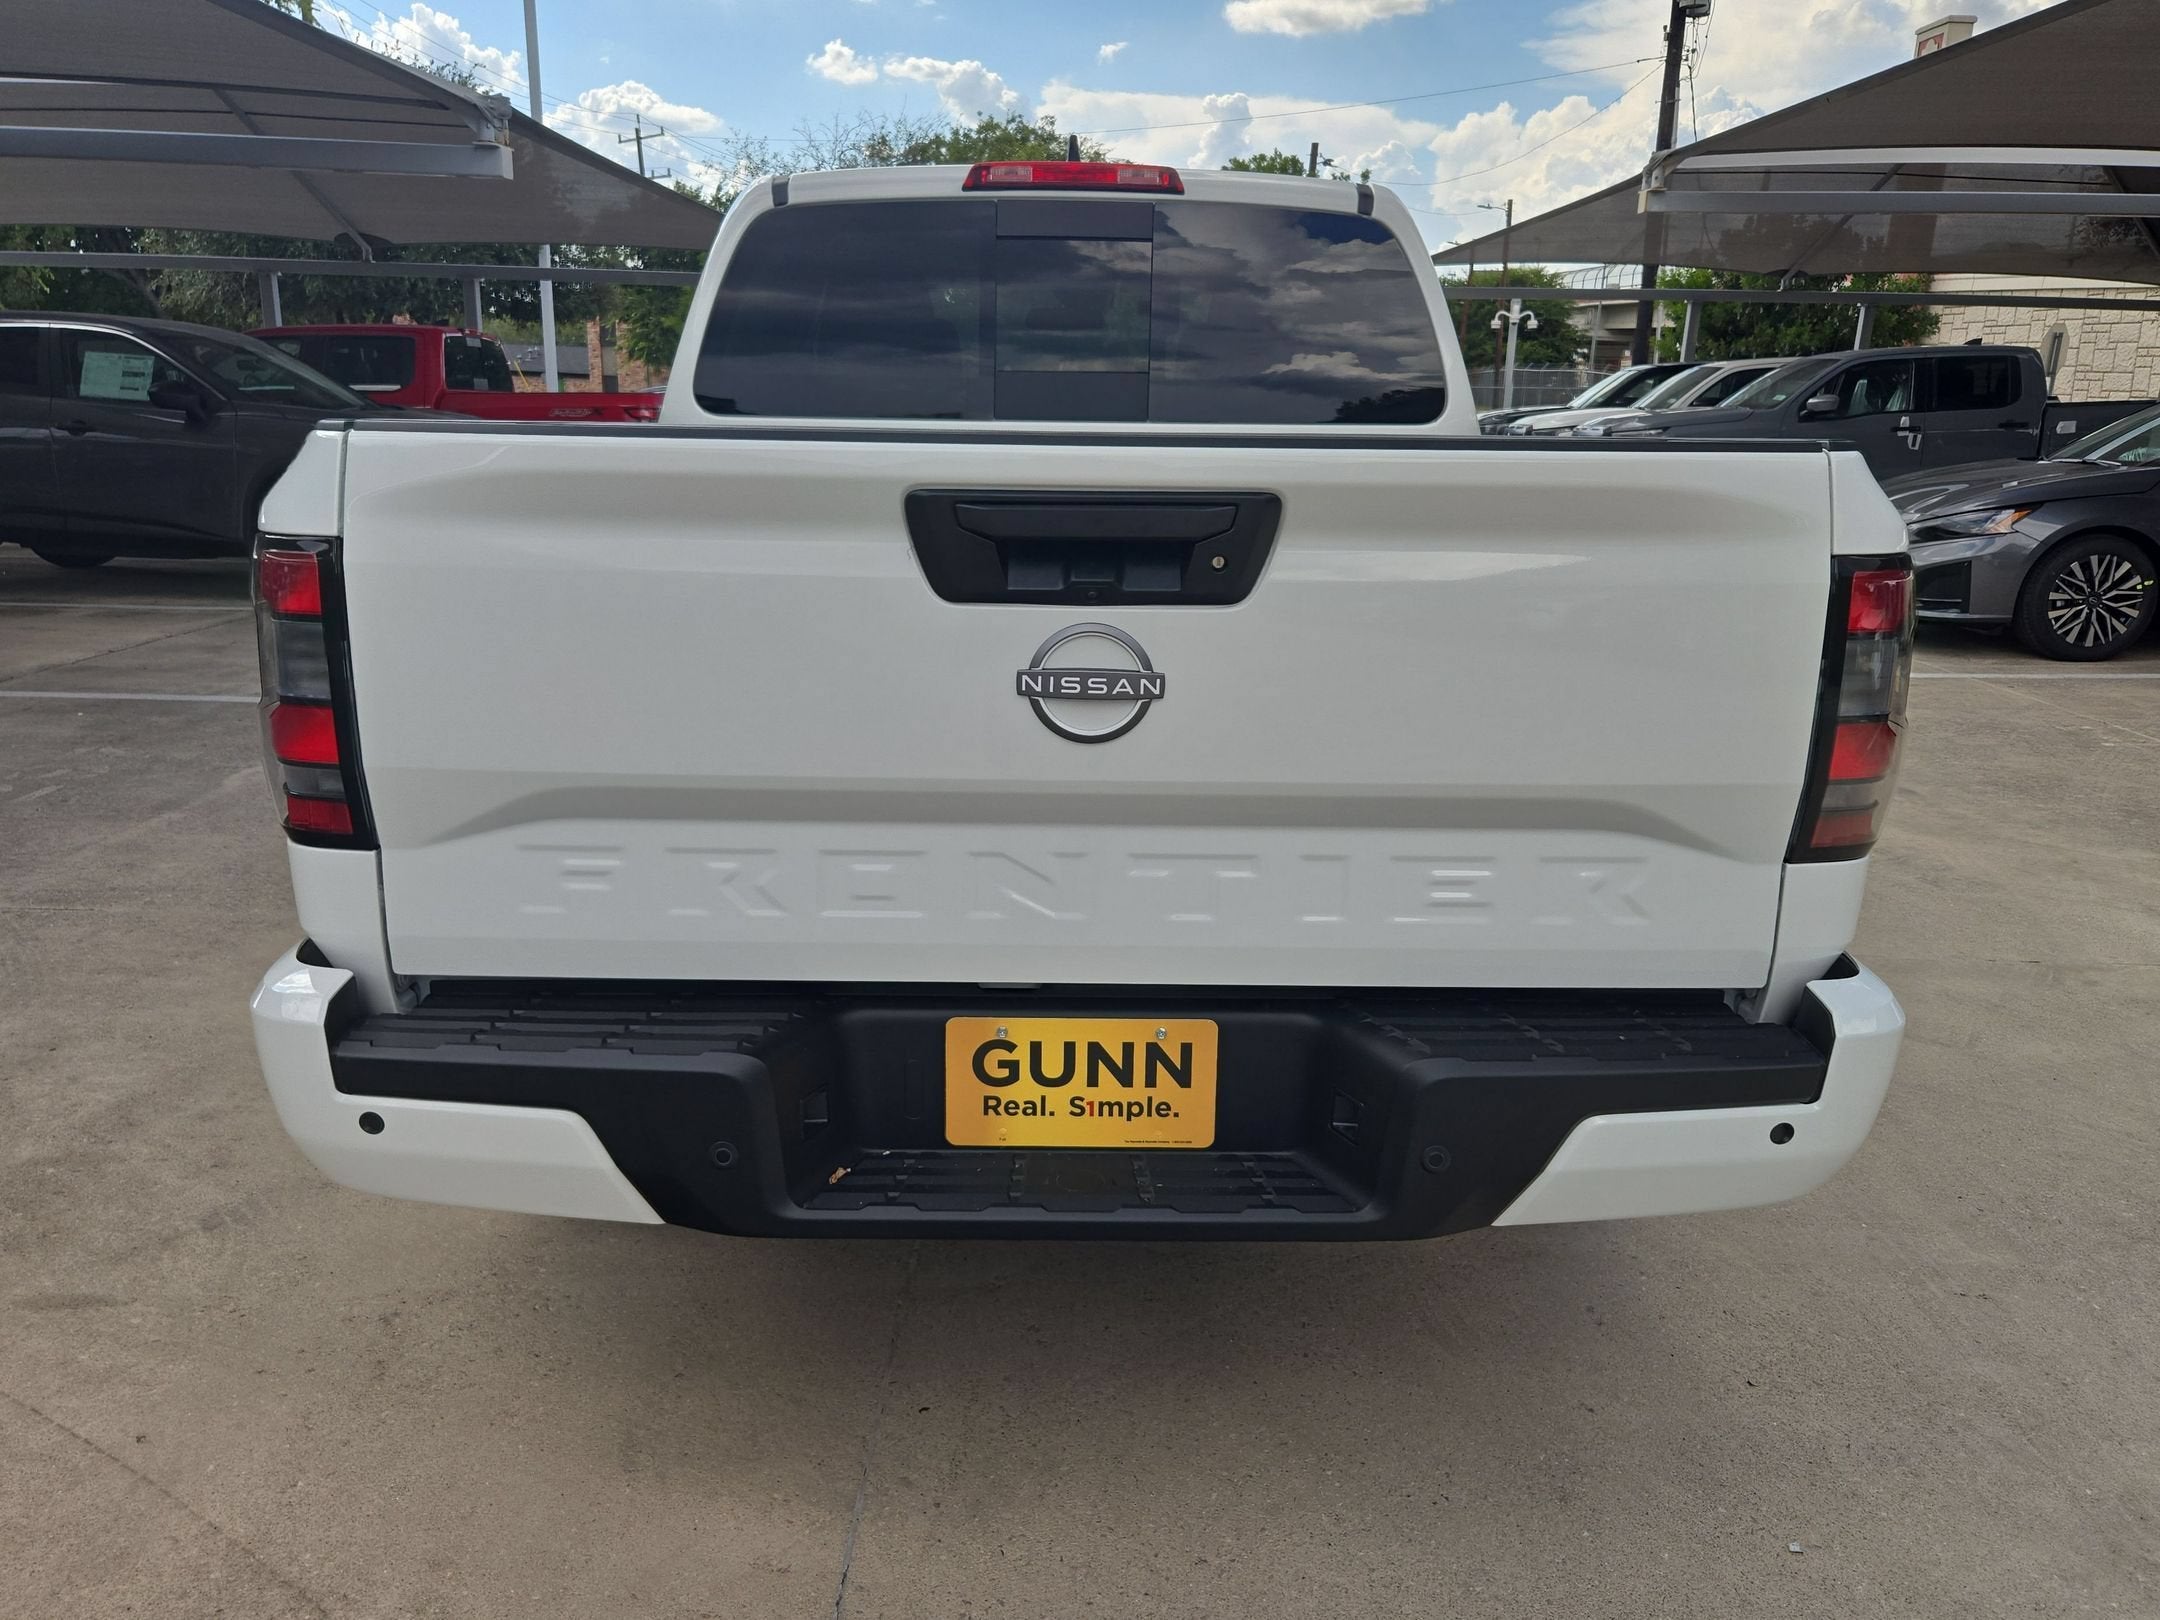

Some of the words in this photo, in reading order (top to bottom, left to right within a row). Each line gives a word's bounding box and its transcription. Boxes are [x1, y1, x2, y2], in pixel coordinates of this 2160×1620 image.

[1021, 674, 1161, 696] NISSAN
[515, 842, 1651, 924] FRONTIER
[971, 1038, 1193, 1089] GUNN
[982, 1094, 1056, 1117] Real.
[1068, 1095, 1180, 1122] S1mple.
